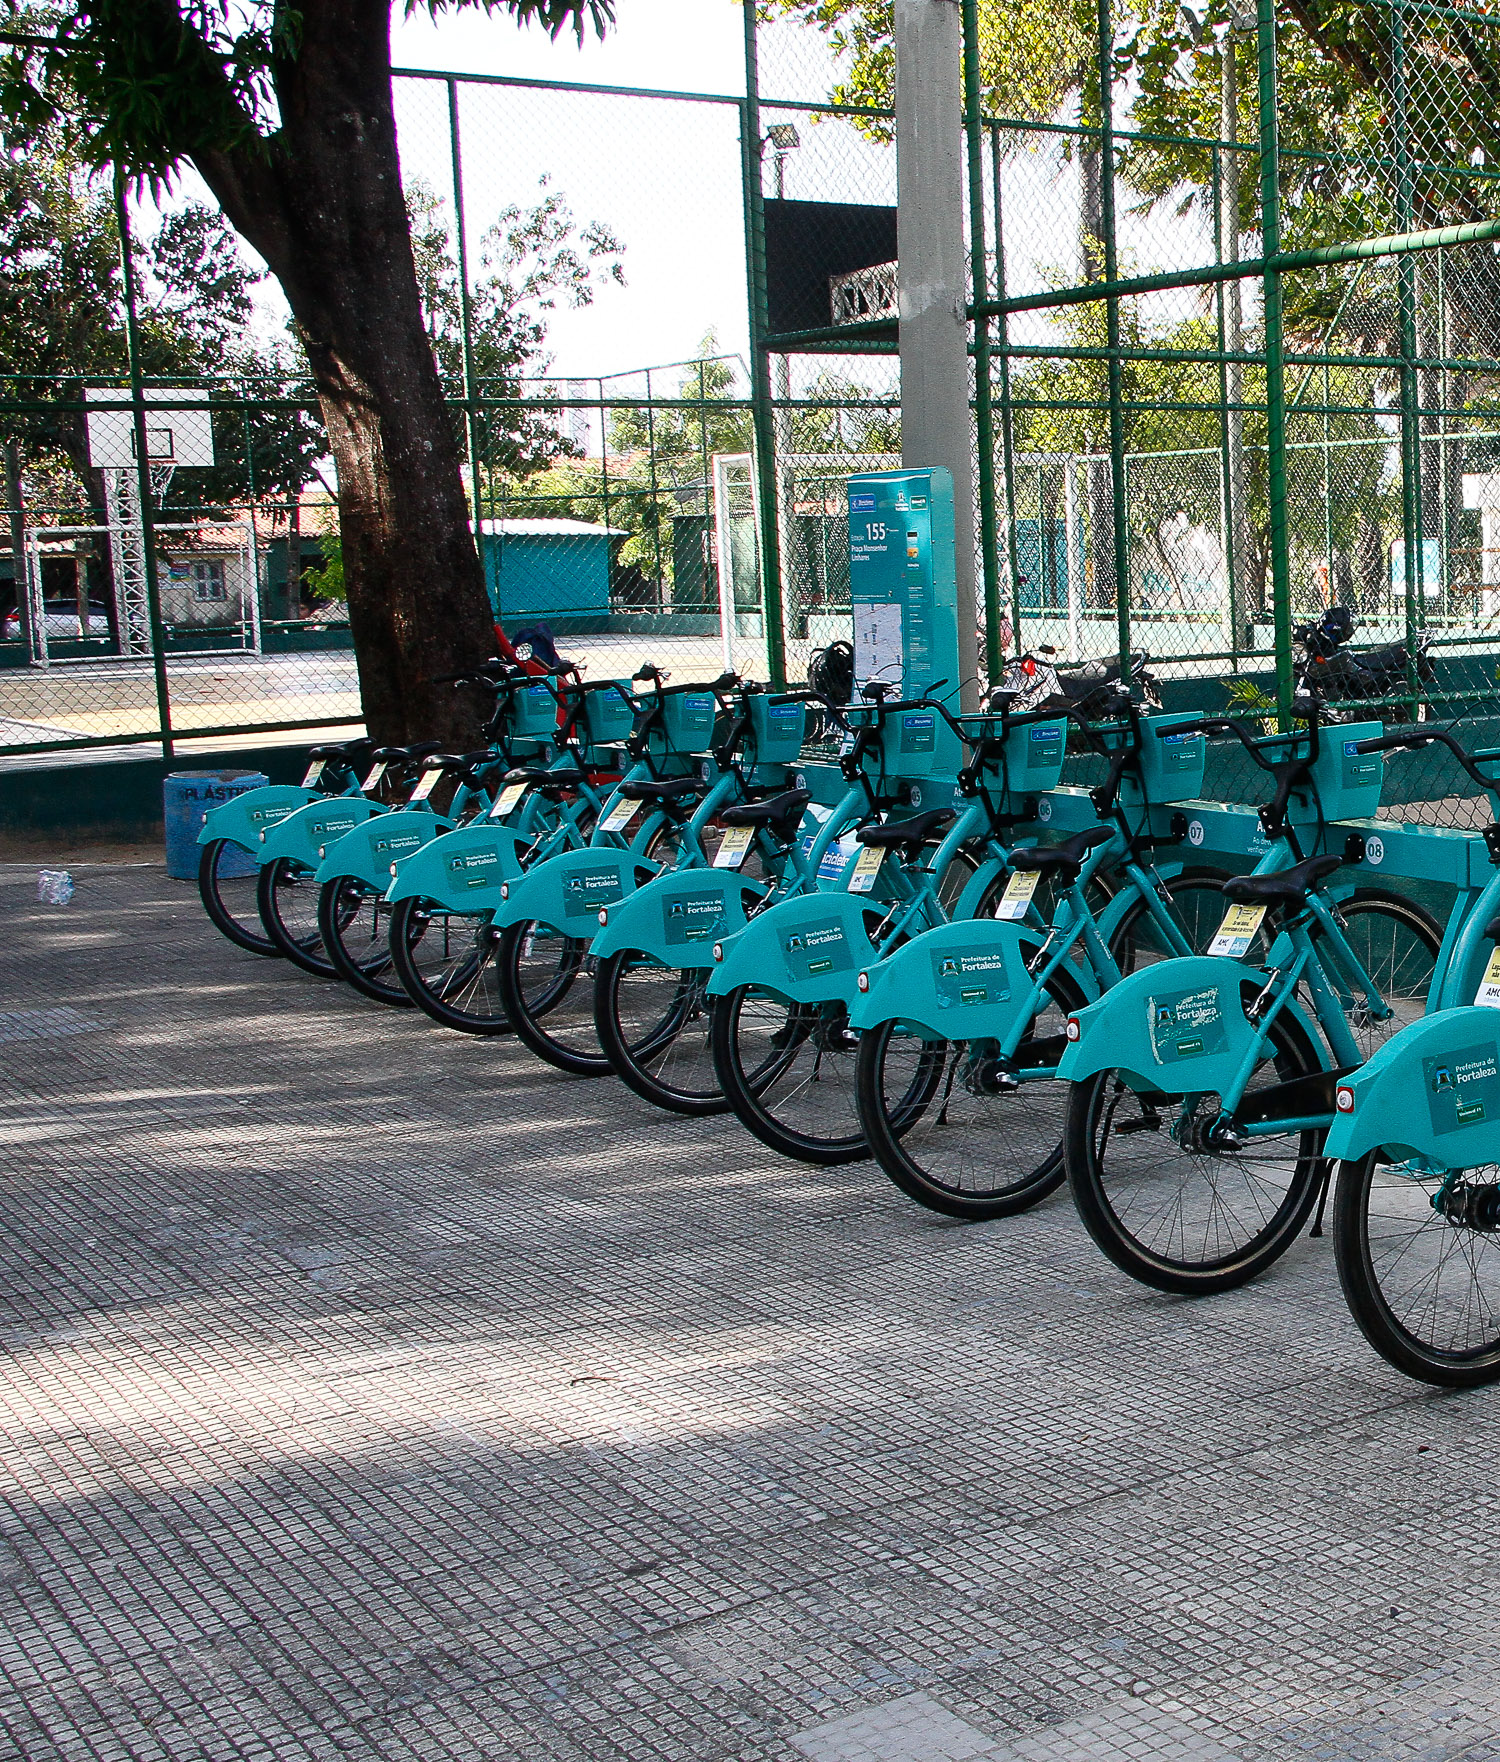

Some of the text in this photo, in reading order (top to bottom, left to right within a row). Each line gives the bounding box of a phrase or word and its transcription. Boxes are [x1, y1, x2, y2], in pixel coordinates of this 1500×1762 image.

[866, 522, 886, 541] 155
[911, 791, 920, 801] 05
[1040, 805, 1051, 816] 06
[1190, 826, 1202, 839] 07
[1368, 843, 1382, 858] 08
[585, 879, 619, 889] Fortaleza
[687, 904, 722, 914] Fortaleza
[805, 926, 841, 939] Prefeitura de
[806, 933, 843, 947] Fortaleza
[960, 956, 989, 964] Prefeitura
[962, 960, 1002, 972] Fortaleza
[1175, 1002, 1206, 1012] Prefeitura
[1176, 1007, 1218, 1021] Fortaleza
[1455, 1060, 1486, 1073] Prefeitura
[1456, 1067, 1497, 1084] Fortaleza
